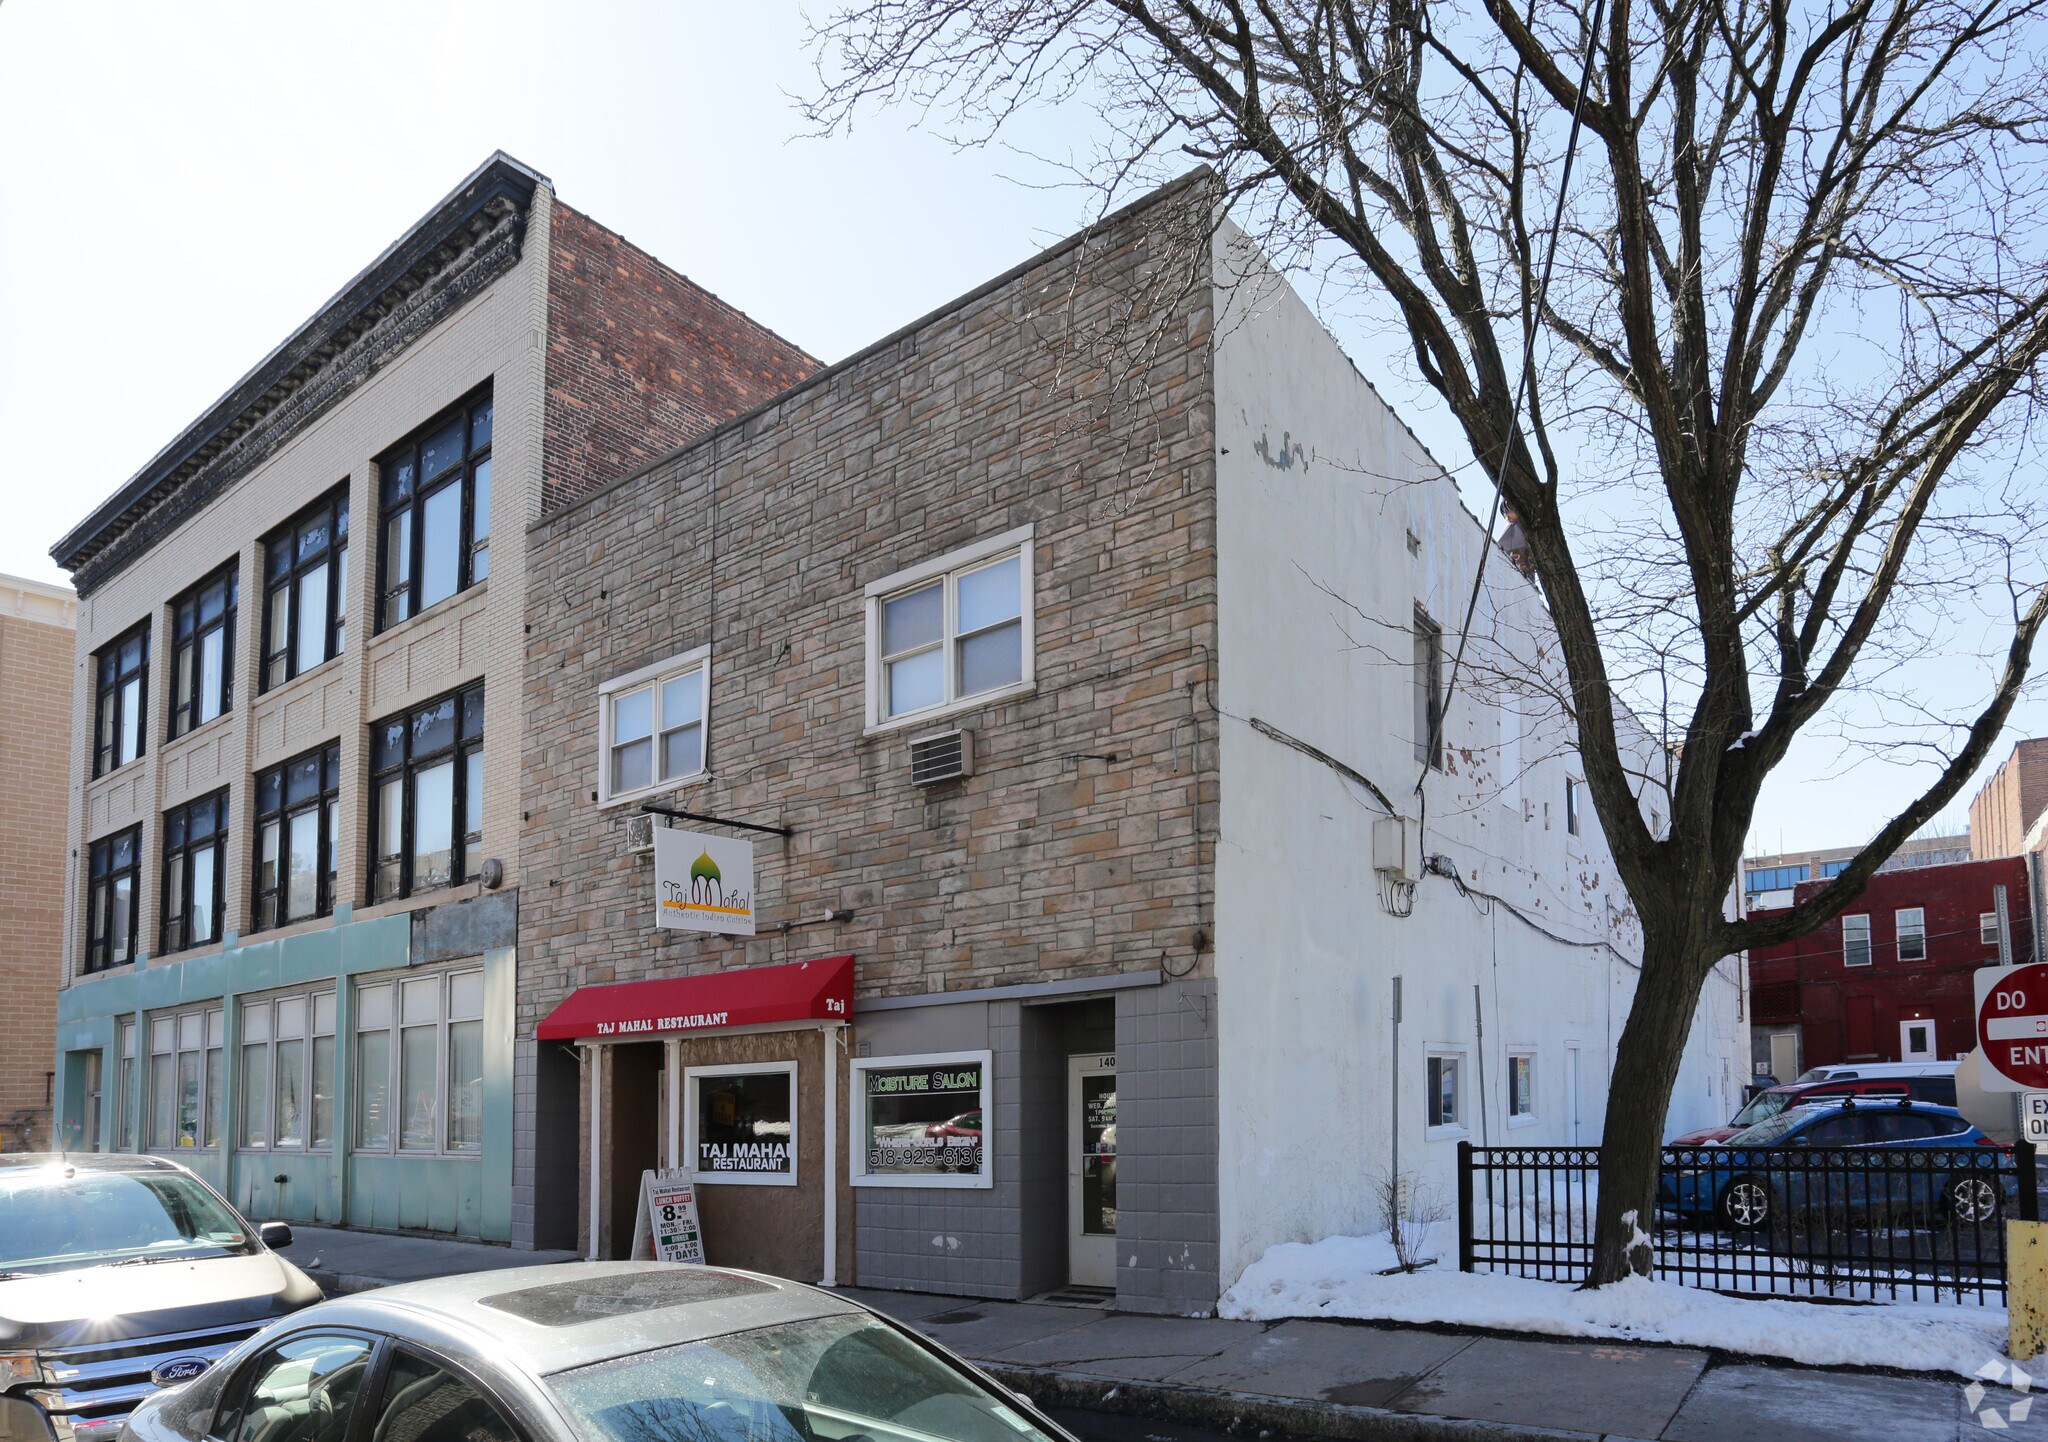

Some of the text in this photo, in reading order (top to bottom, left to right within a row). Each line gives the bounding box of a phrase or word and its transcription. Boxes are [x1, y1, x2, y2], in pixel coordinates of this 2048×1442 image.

[663, 874, 750, 910] Taj Mahal
[662, 907, 752, 925] Authentic Indian Cuisine
[826, 998, 845, 1012] Taj
[1996, 990, 2026, 1011] DO
[597, 1012, 728, 1034] TAJ MAHAL RESTAURANT
[1100, 1057, 1115, 1067] 140
[2010, 1045, 2048, 1065] ENT
[869, 1072, 976, 1092] MOISTURE SALON
[700, 1142, 728, 1158] TAJ
[870, 1147, 982, 1166] 518-925-8136
[713, 1157, 783, 1170] RESTAURANT
[656, 1194, 690, 1205] LUNCH BUFFET
[660, 1227, 678, 1235] 11:30
[665, 1244, 679, 1252] 4:00
[666, 1252, 672, 1262] 7
[676, 1249, 698, 1260] DAYS
[169, 1363, 198, 1379] Ford
